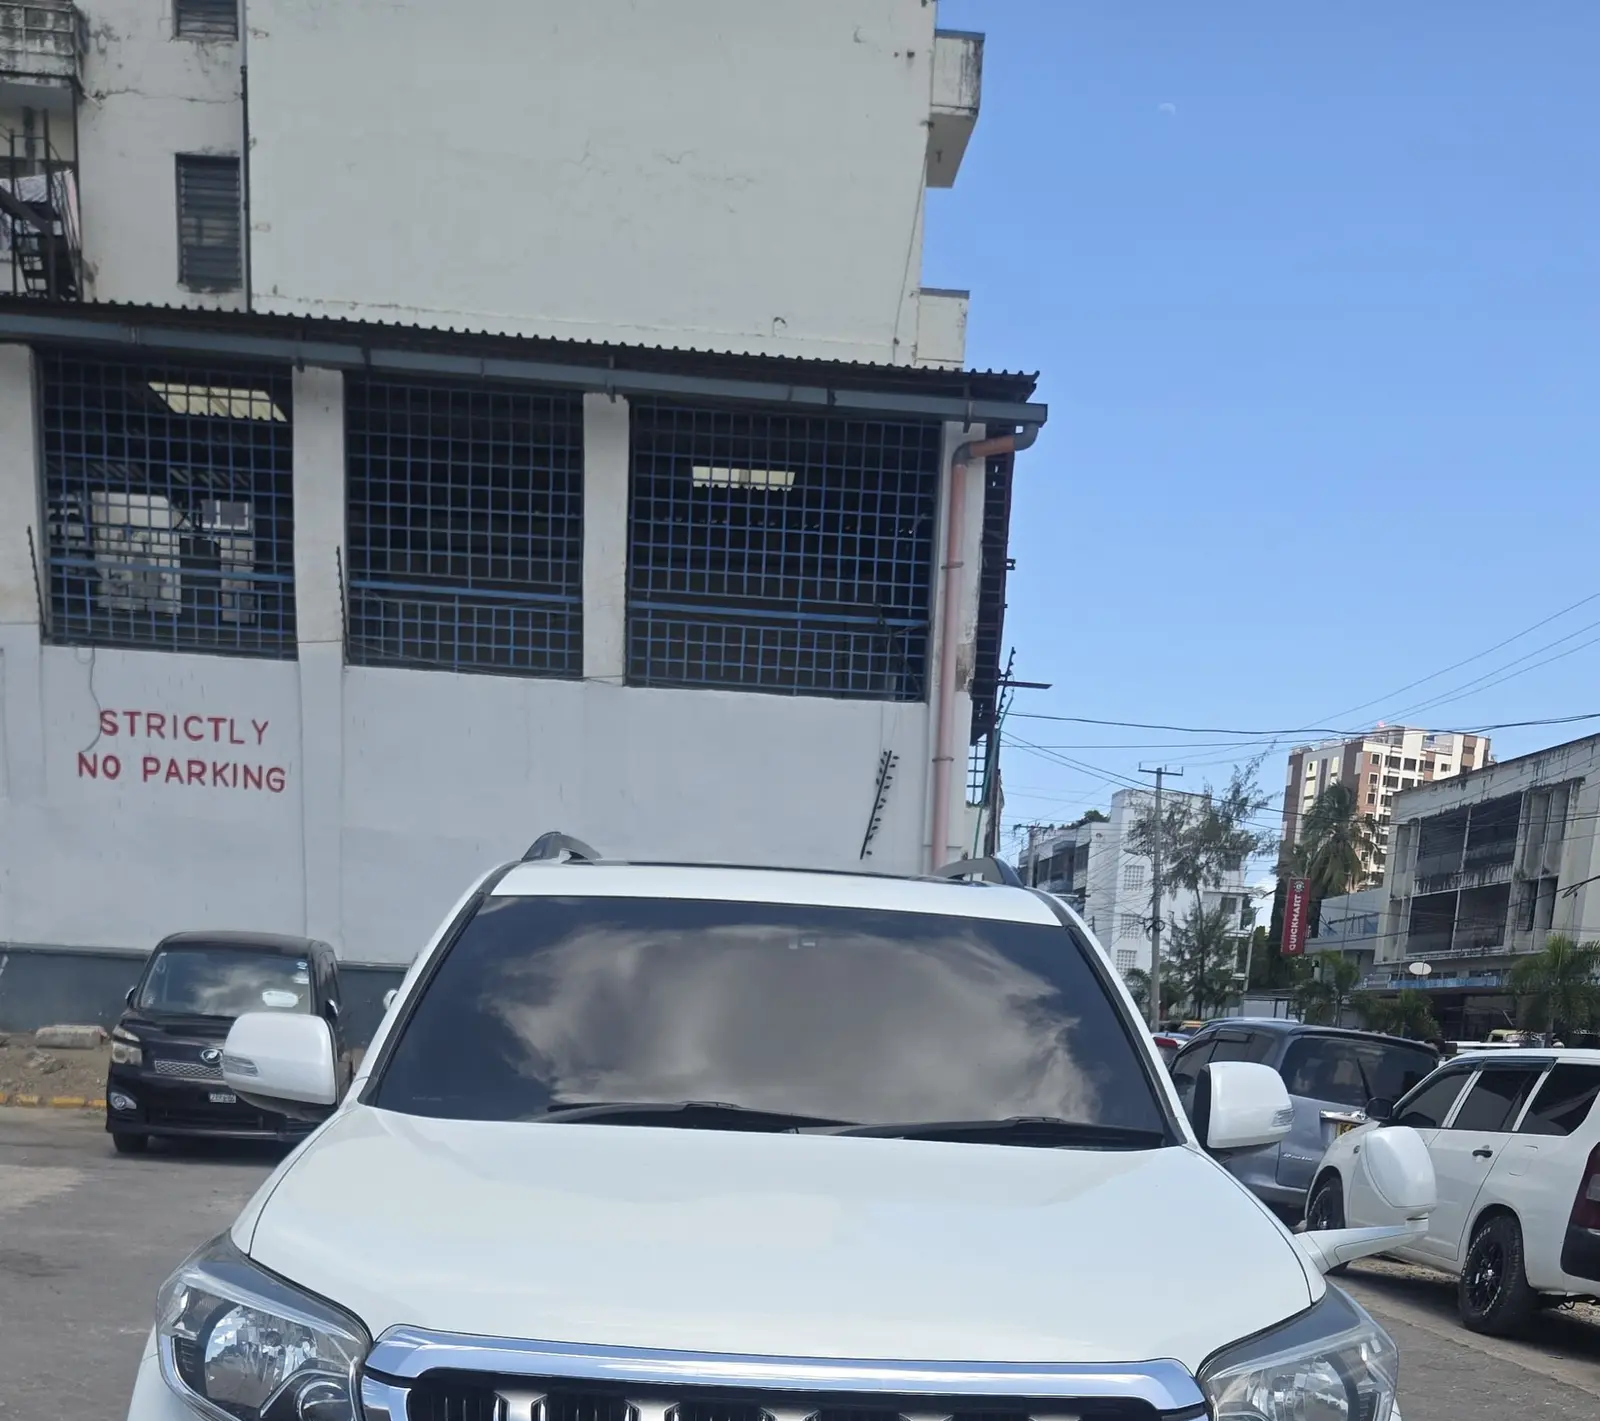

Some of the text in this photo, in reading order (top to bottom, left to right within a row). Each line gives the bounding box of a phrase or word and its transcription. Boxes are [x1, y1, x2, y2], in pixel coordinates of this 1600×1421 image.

[100, 709, 269, 745] STRICTLY
[77, 751, 286, 793] NO PARKING
[1289, 894, 1302, 951] QUICKMART
